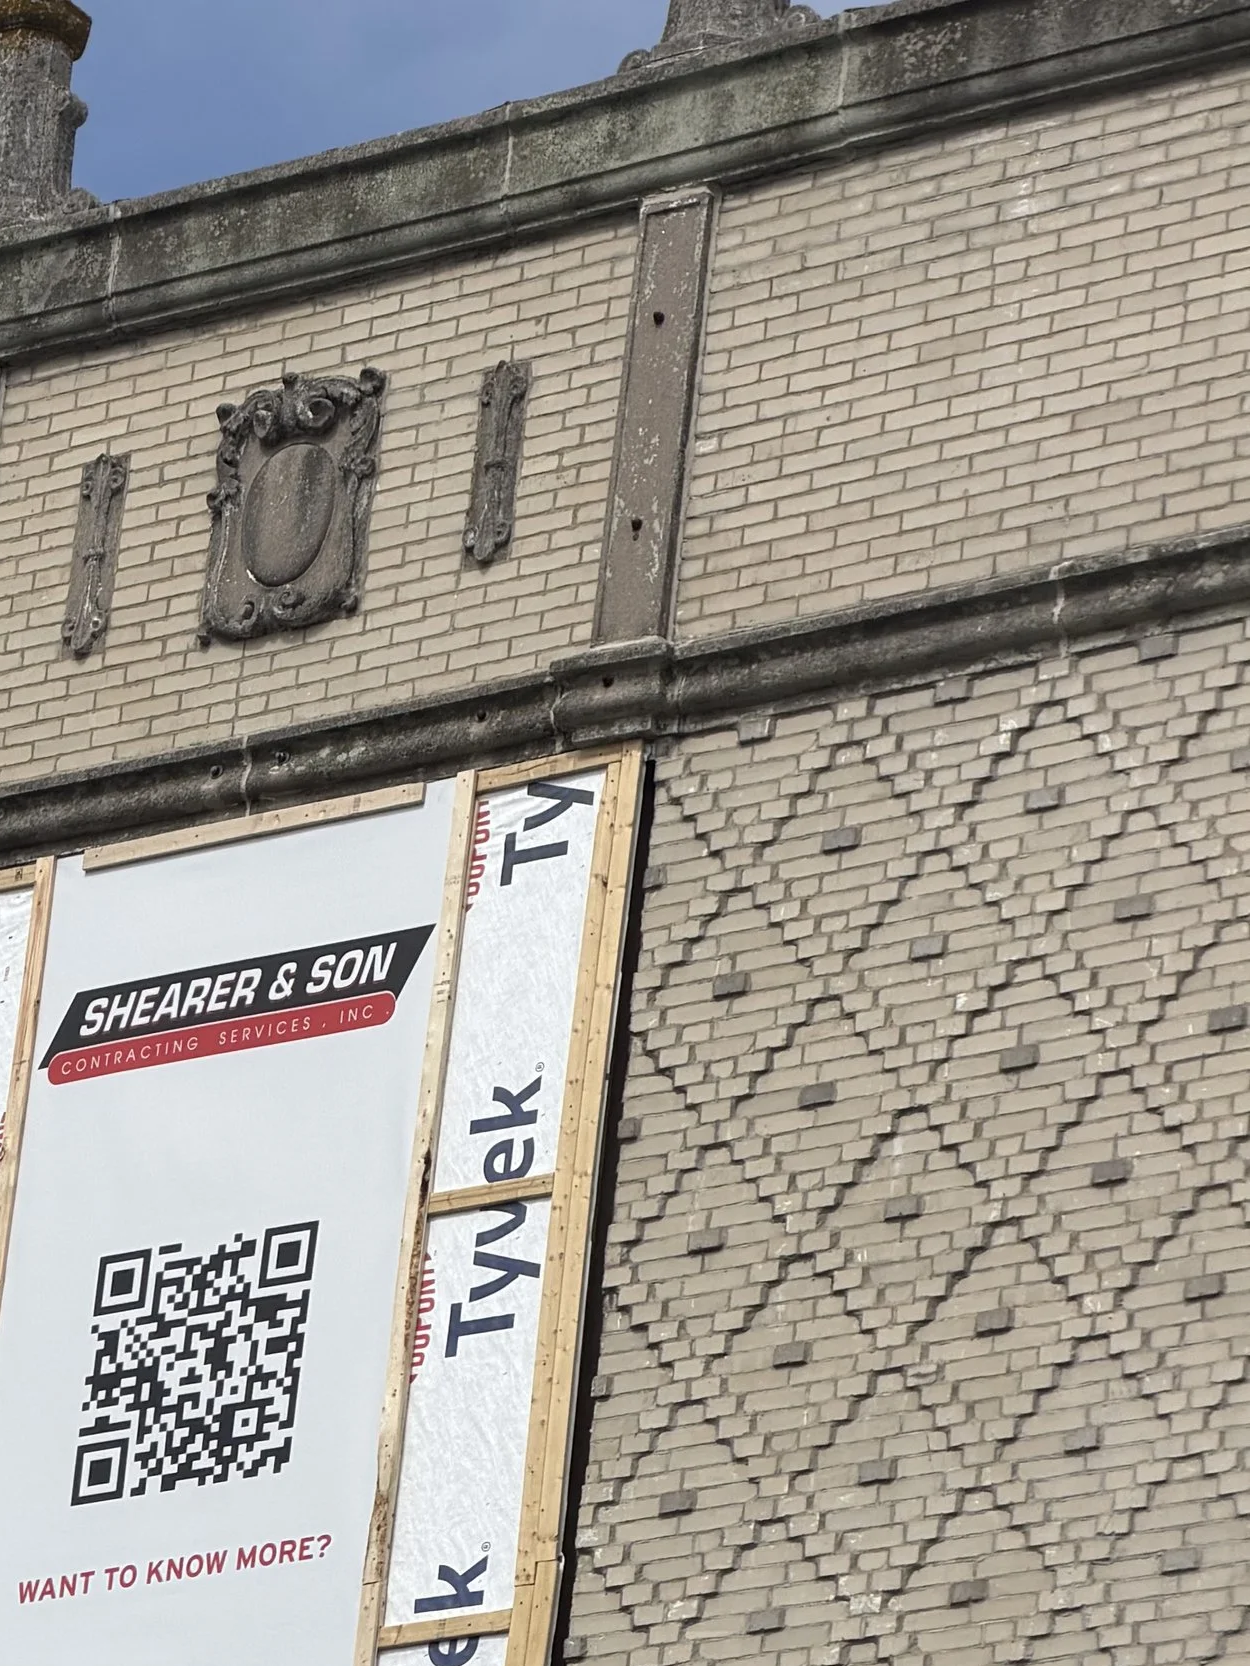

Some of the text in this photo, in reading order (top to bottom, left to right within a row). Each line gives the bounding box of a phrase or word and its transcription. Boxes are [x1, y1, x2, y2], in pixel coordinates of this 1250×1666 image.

[78, 967, 263, 1036] SHEARER
[269, 961, 297, 1000] &
[306, 941, 398, 994] SON
[61, 1036, 199, 1076] CONTRACTING
[18, 1534, 333, 1604] WANT TO KNOW MORE?
